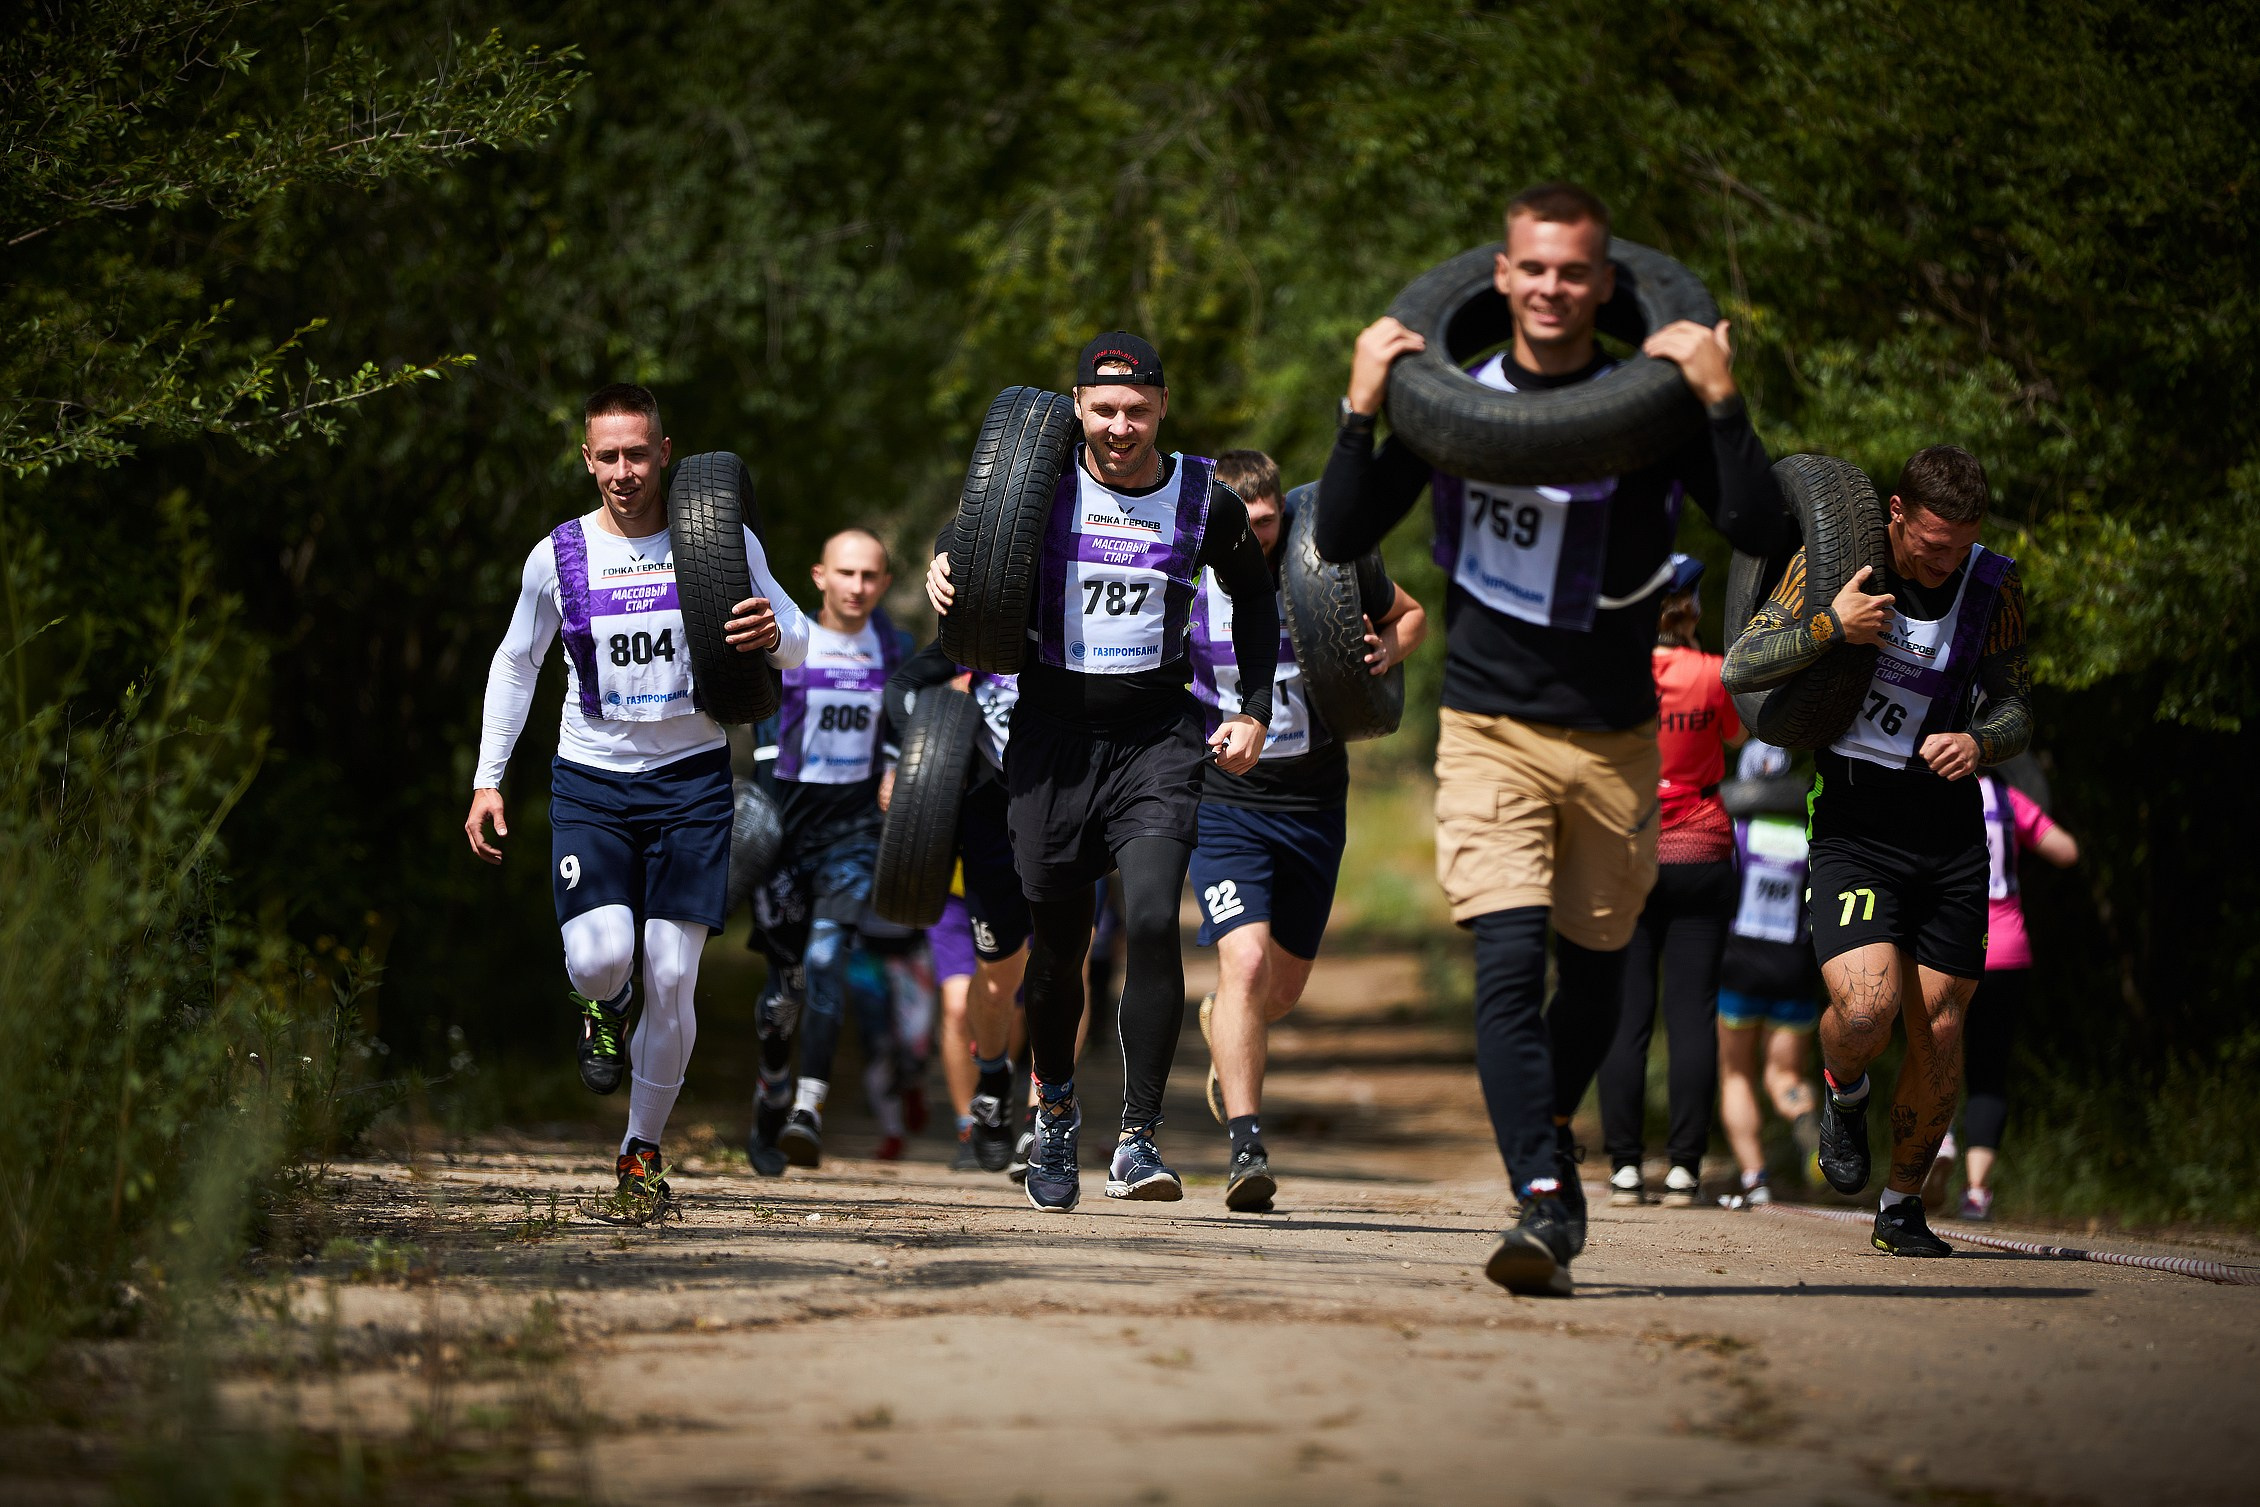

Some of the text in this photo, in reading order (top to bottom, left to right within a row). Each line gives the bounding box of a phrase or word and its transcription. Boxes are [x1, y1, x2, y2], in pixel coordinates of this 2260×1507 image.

[1088, 514, 1161, 530] ГОНКА ГЕРОЕВ
[1470, 490, 1542, 549] 759
[1092, 537, 1150, 554] МАССОВЫЙ
[1103, 552, 1135, 564] СТАРТ
[603, 562, 673, 576] ГОНКА ГЕРОЕВ
[611, 583, 668, 601] МАССОВЫЙ
[1084, 581, 1150, 616] 787
[625, 599, 656, 612] СТАРТ
[610, 628, 676, 667] 804
[1093, 644, 1159, 657] ГАЗПРОМБАНК
[1901, 639, 1937, 656] ГЕРОЕВ
[1875, 667, 1906, 683] СТАРТ
[1876, 656, 1923, 679] АССОВЫЙ
[626, 689, 689, 705] ГАЗПРОМБАНК
[819, 704, 870, 732] 806
[1657, 706, 1715, 732] НТЁР
[1862, 689, 1908, 736] 76
[559, 854, 581, 891] 9
[1204, 879, 1242, 917] 22
[1837, 888, 1876, 927] 77
